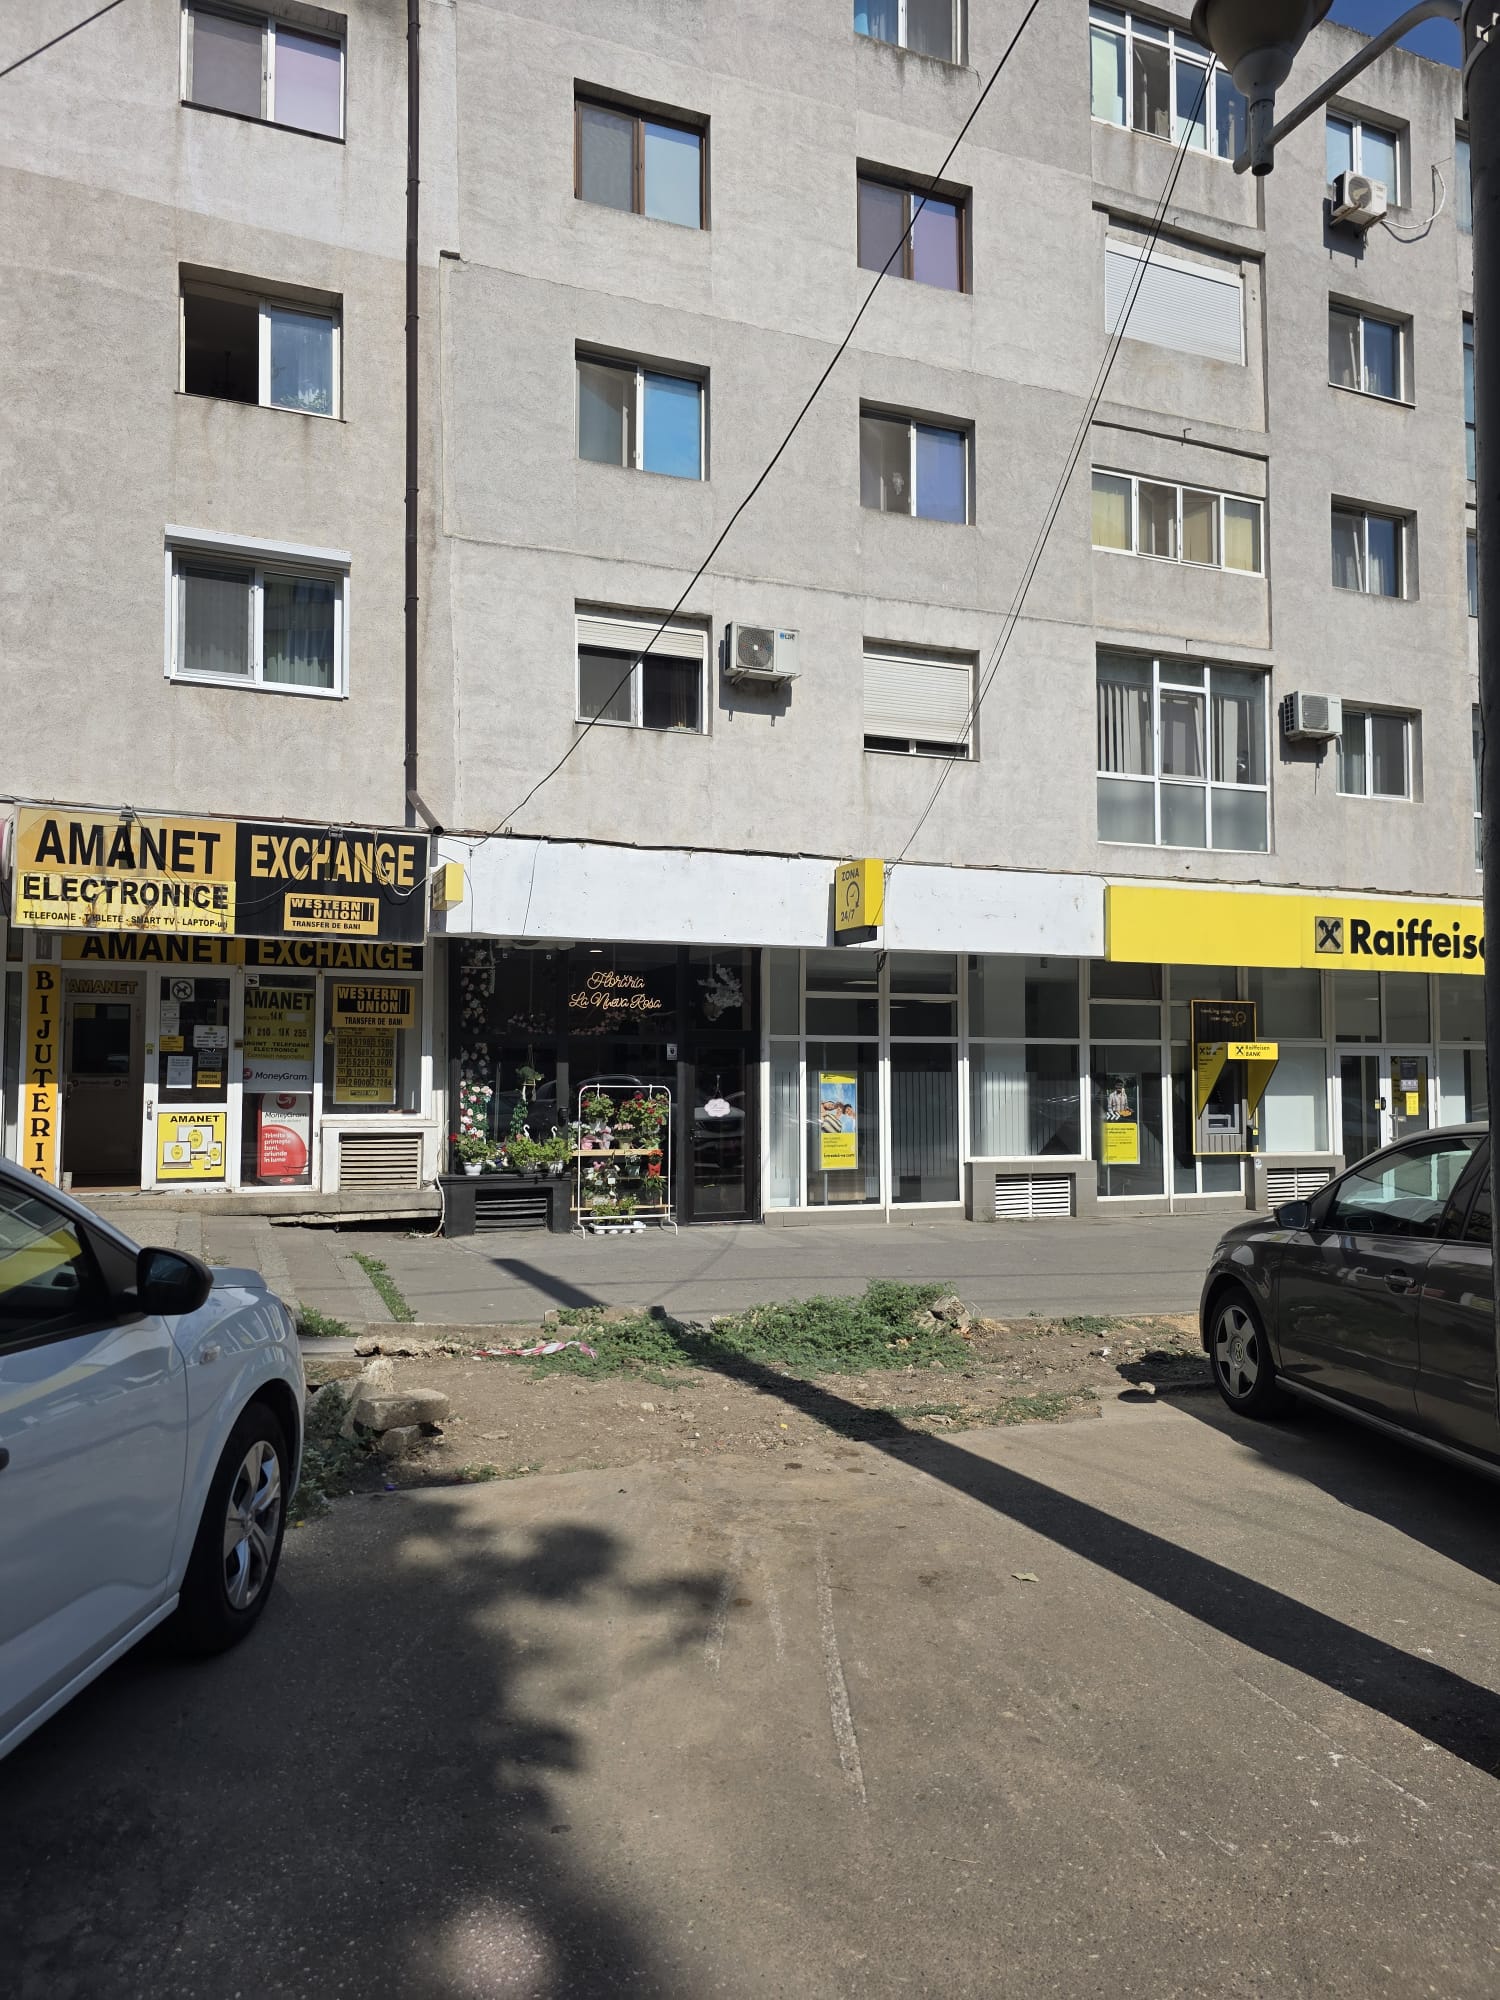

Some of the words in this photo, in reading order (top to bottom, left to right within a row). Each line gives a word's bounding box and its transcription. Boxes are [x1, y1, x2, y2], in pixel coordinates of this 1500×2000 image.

[35, 819, 220, 875] AMANET
[250, 834, 415, 886] EXCHANGE
[841, 868, 860, 882] ZONA
[23, 876, 229, 910] ELECTRONICE
[291, 898, 361, 911] WESTERN
[23, 910, 76, 921] TELEFOANE
[164, 917, 175, 926] TV
[313, 909, 361, 921] UNION
[840, 908, 856, 923] 24/7
[292, 920, 330, 929] TRANSFER
[1350, 918, 1485, 960] Raiffeis
[80, 932, 235, 963] AMANET
[258, 939, 413, 969] EXCHANGE
[67, 978, 138, 994] AMANET
[244, 990, 314, 1010] AMANET
[338, 987, 399, 1001] WESTERN
[569, 991, 590, 1009] La
[630, 993, 663, 1011] Rosa
[357, 1000, 399, 1013] UNION
[345, 1017, 376, 1026] TRANSFER
[377, 1017, 386, 1026] DE
[389, 1017, 403, 1026] BANI
[255, 1071, 308, 1082] MoneyGram
[170, 1115, 220, 1123] AMANET
